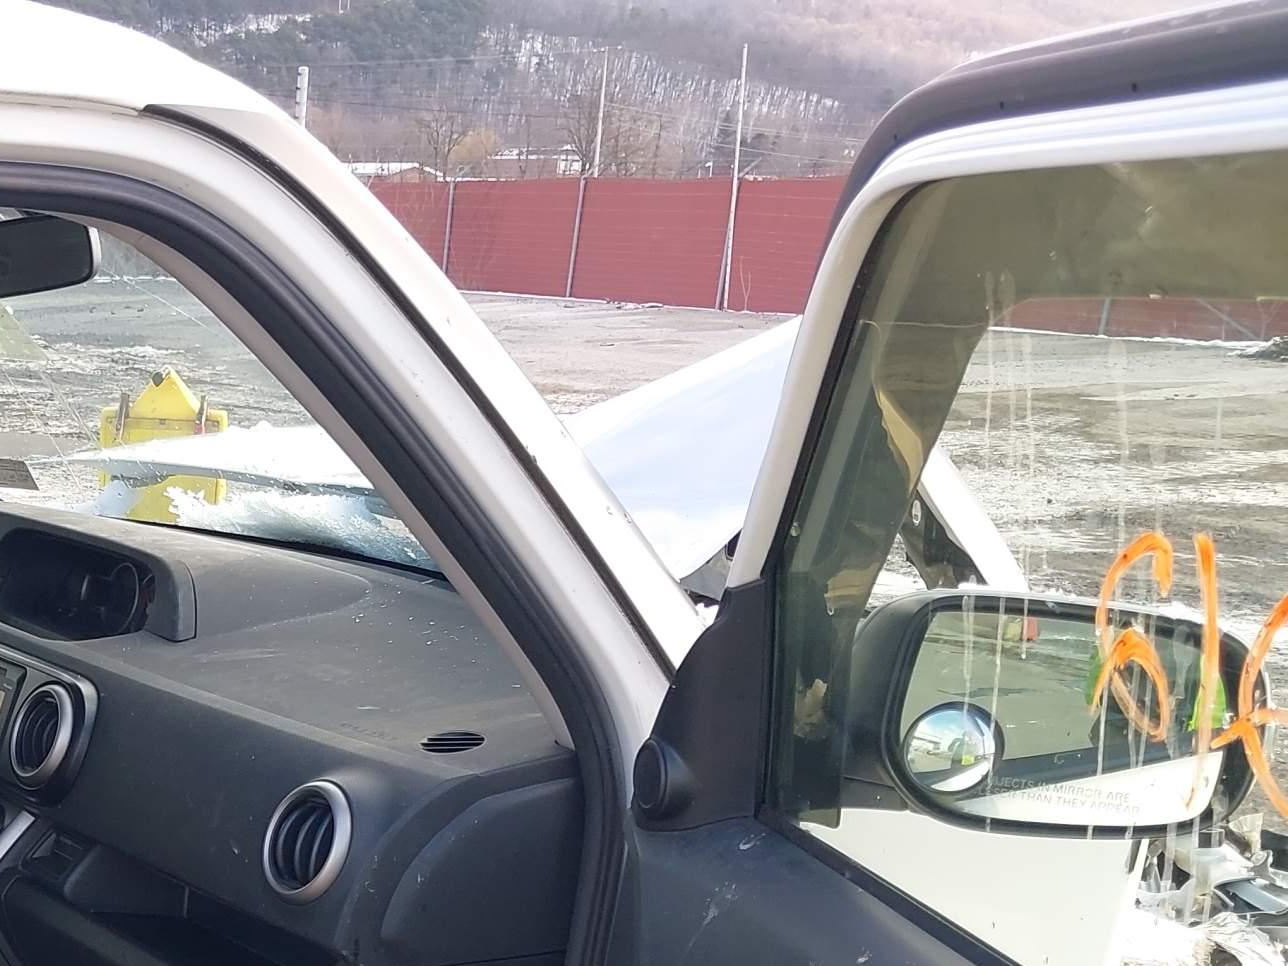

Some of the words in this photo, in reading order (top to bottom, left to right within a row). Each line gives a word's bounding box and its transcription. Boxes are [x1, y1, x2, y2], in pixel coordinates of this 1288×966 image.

[1020, 791, 1052, 804] THAN
[1056, 796, 1088, 809] THEY
[1038, 781, 1050, 793] IN
[1052, 784, 1102, 800] MIRROR
[1106, 791, 1130, 803] ARE
